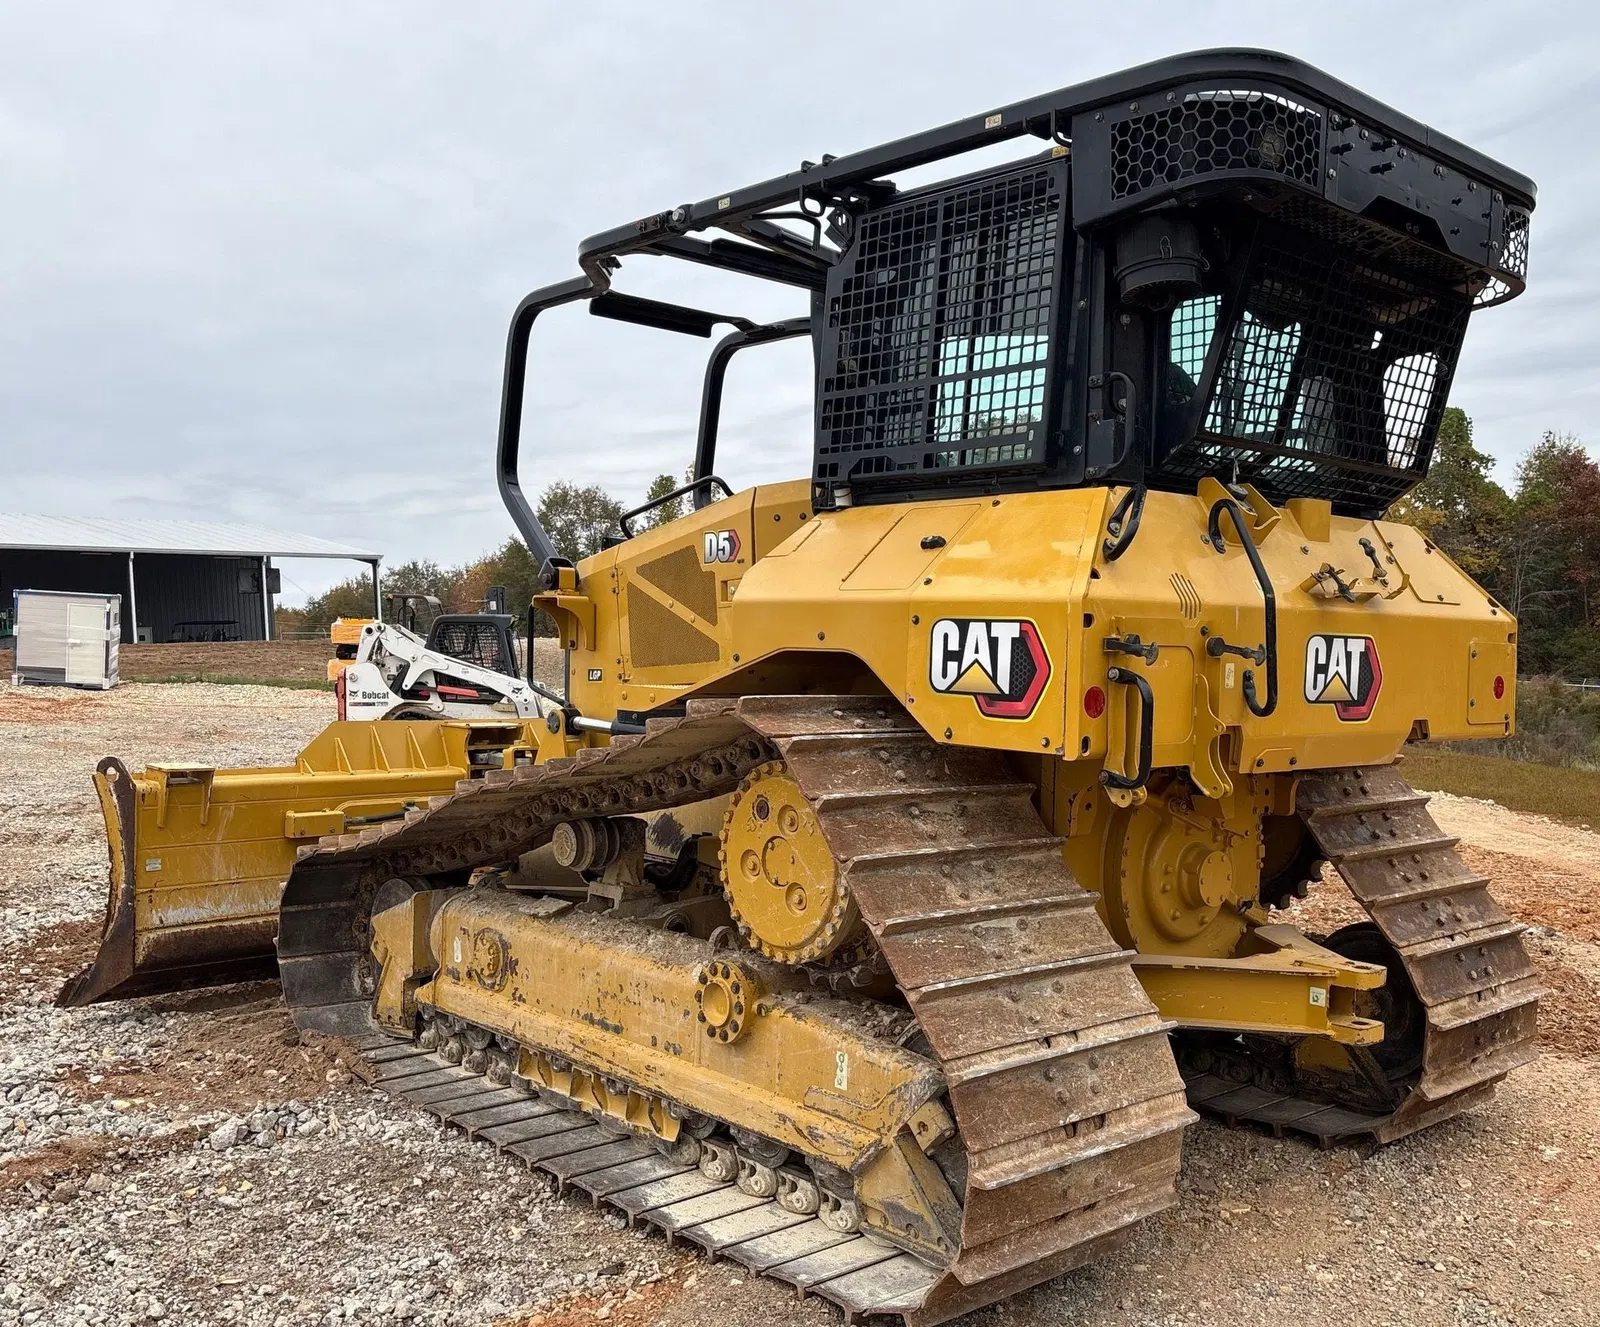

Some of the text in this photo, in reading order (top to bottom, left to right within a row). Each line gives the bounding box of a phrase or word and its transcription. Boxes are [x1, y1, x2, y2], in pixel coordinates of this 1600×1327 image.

[704, 531, 730, 563] D5
[931, 620, 1020, 695] CAT
[1306, 636, 1365, 700] CAT
[589, 670, 601, 680] LGP
[361, 691, 389, 699] Bobcat
